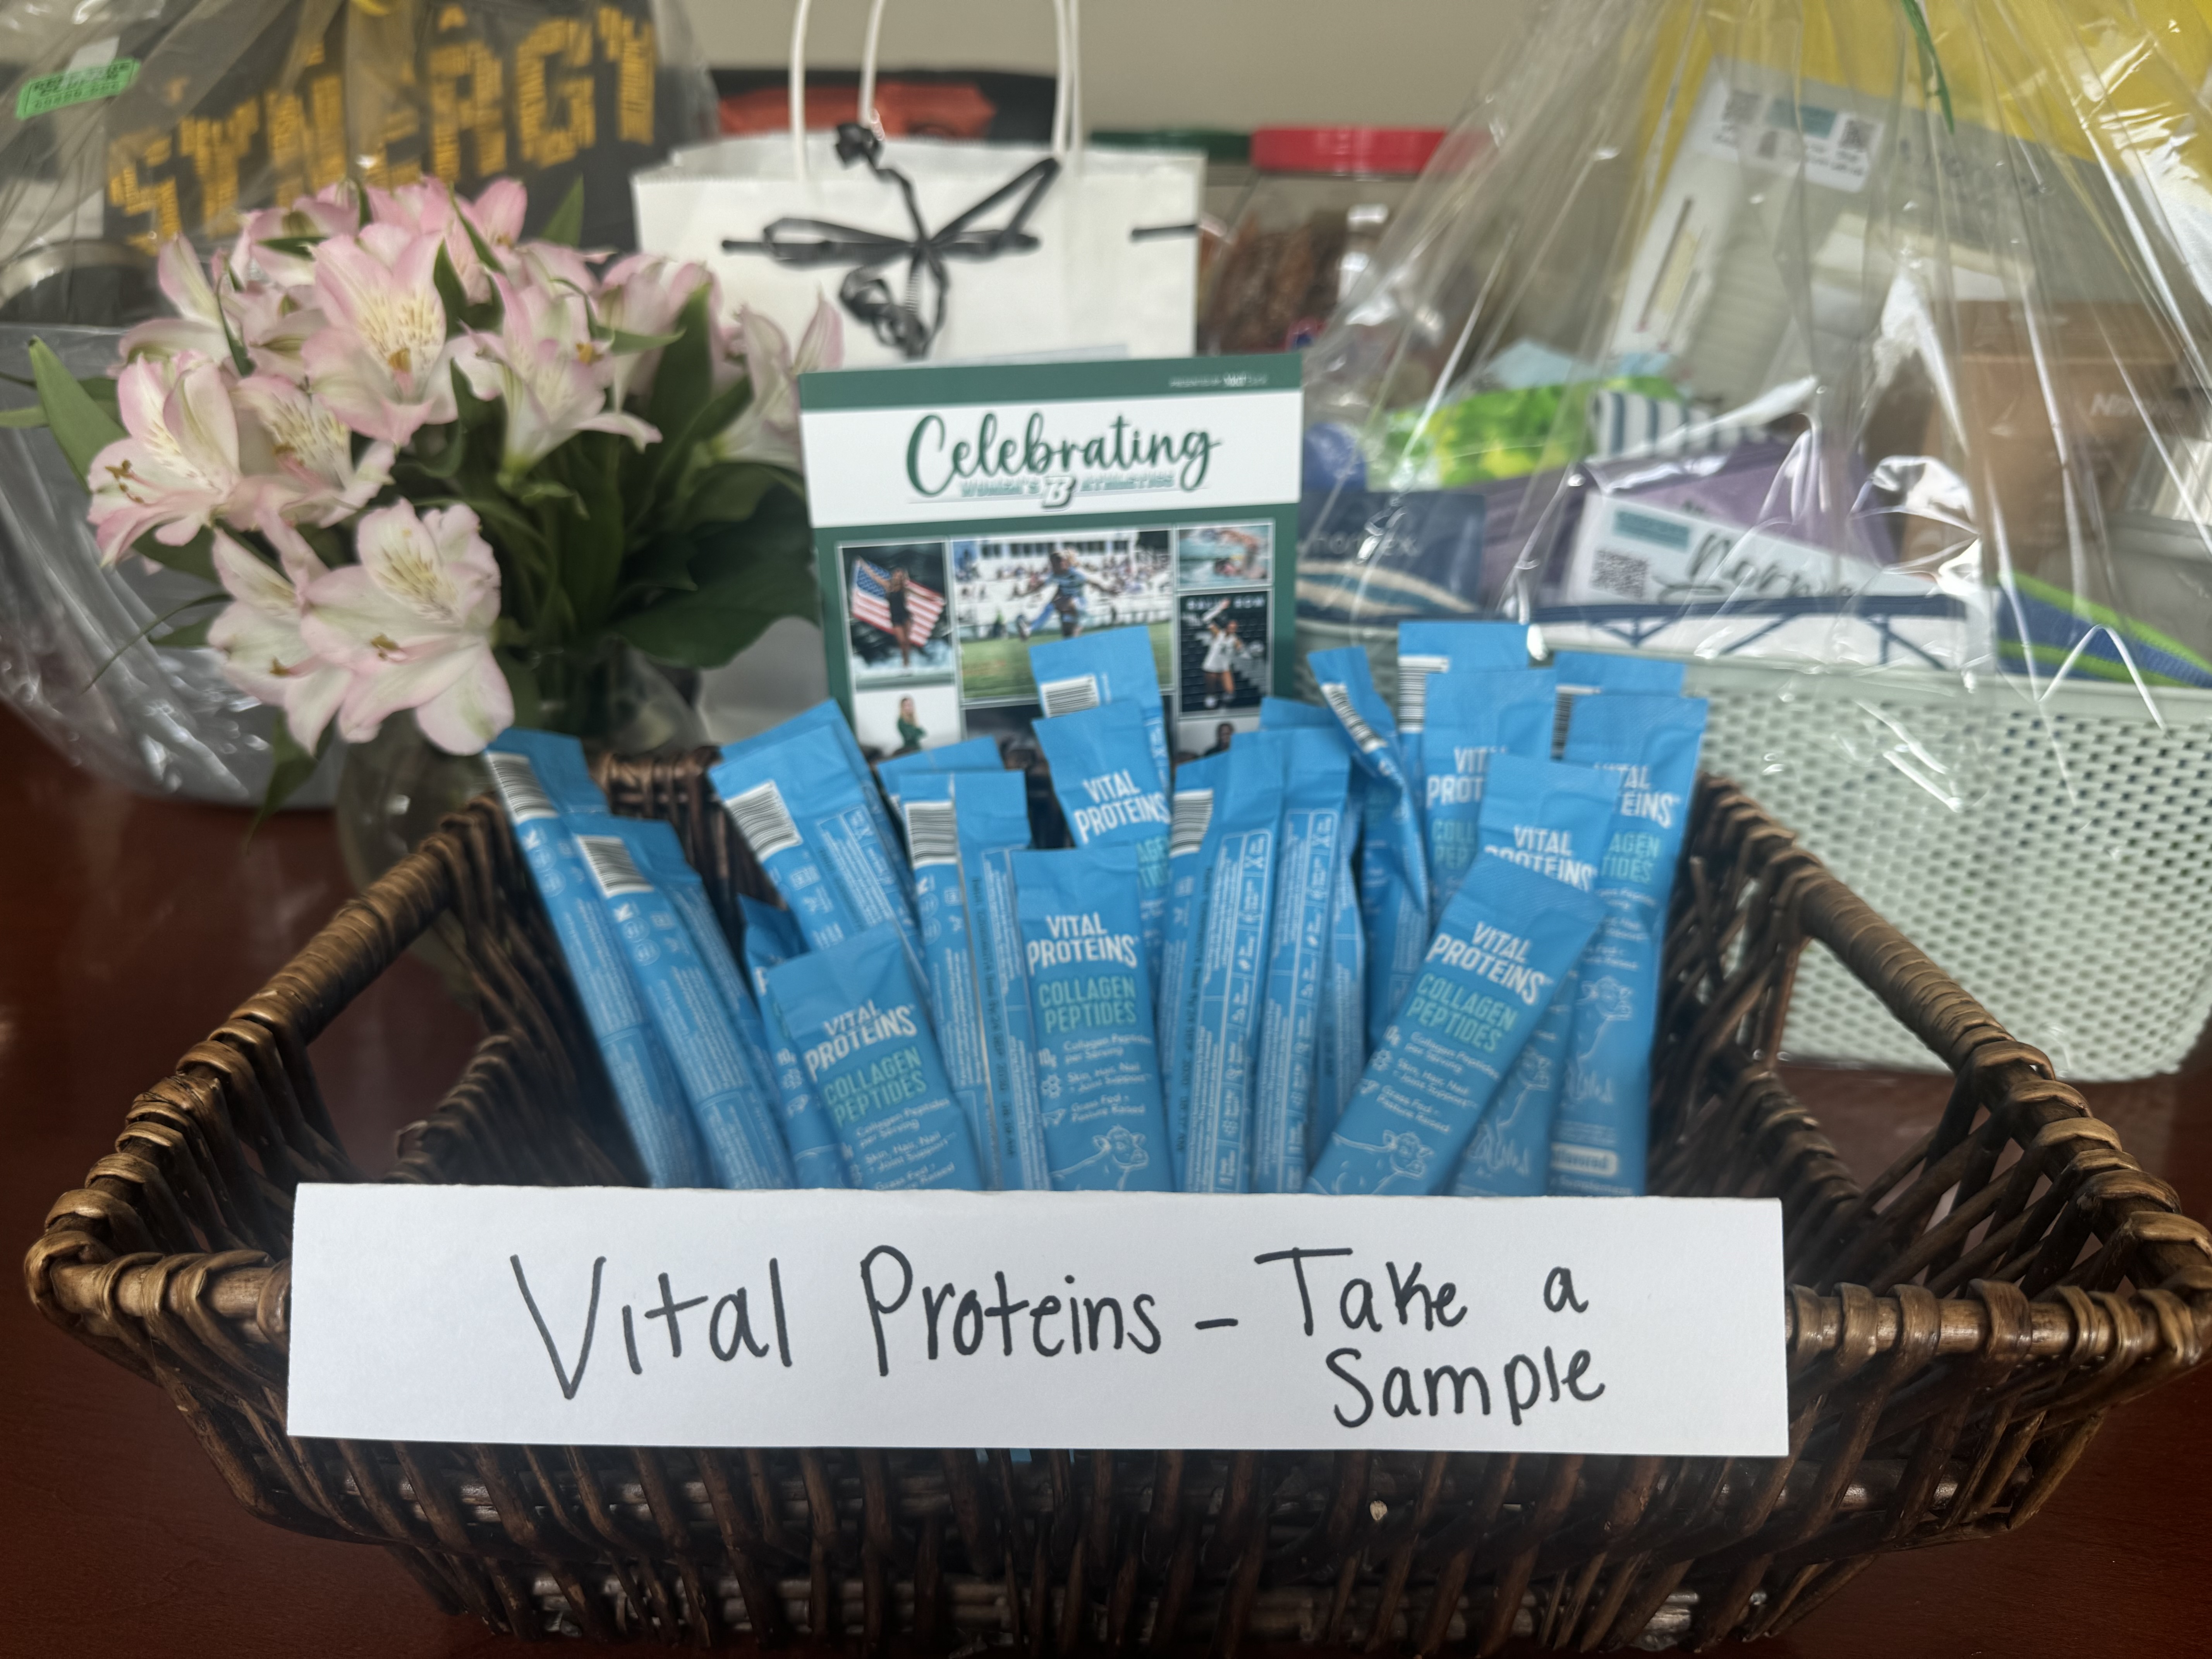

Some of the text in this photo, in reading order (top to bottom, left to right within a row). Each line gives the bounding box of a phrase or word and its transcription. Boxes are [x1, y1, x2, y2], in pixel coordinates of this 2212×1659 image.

[906, 413, 1221, 497] Celebrating
[1082, 768, 1141, 804] VITAL
[1074, 792, 1171, 845] PROTEINS
[1514, 825, 1572, 857] VITAL
[1046, 912, 1108, 938] VITAL
[1473, 921, 1531, 963] VITAL
[1027, 934, 1137, 977] PROTEINS
[1425, 933, 1546, 1005] PROTEINS
[1039, 975, 1136, 1007] COLLAGEN
[1416, 972, 1518, 1032] COLLAGEN
[824, 998, 880, 1036] VITAL
[1045, 1000, 1136, 1034] PEPTIDES
[1406, 997, 1503, 1053] PEPTIDES
[804, 1005, 917, 1084] PROTEINS
[1064, 1037, 1109, 1052] Collagen
[1085, 1047, 1123, 1060] Serving
[1410, 1030, 1500, 1079] Collagen Peptides
[1426, 1049, 1463, 1074] Serving
[824, 1047, 922, 1106] COLLAGEN
[834, 1070, 926, 1129] PEPTIDES
[856, 1098, 950, 1138] Collagen Peptides
[879, 1119, 920, 1138] Serving
[510, 1254, 792, 1400] Vital
[860, 1245, 1161, 1377] Proteins
[1254, 1247, 1468, 1336] Take
[1544, 1267, 1589, 1313] a
[1326, 1346, 1606, 1428] Sample
